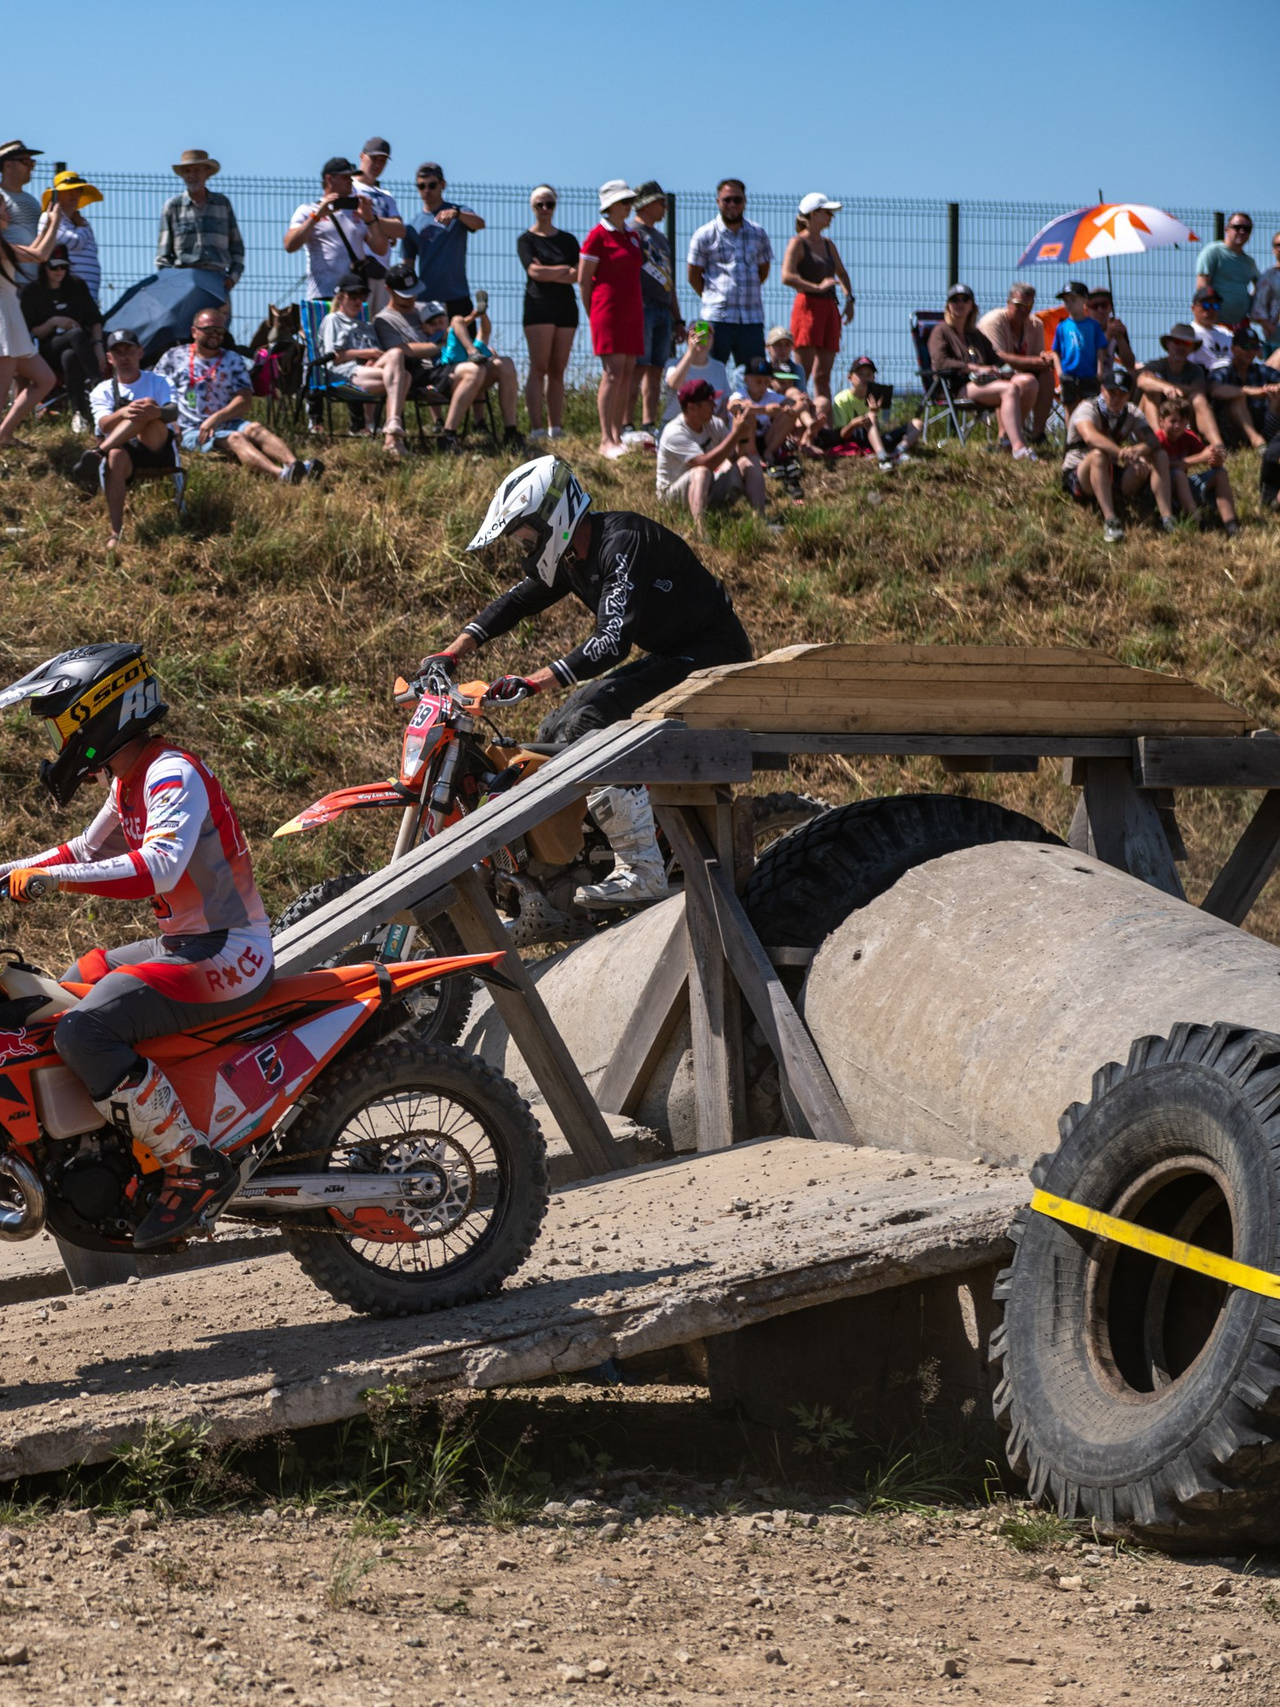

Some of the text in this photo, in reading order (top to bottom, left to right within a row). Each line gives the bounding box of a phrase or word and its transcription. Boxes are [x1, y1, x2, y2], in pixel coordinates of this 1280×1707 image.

[583, 637, 619, 662] Troy
[254, 1044, 285, 1085] 5
[8, 1111, 31, 1122] KTM
[223, 1125, 254, 1149] MOTOREX
[323, 1184, 345, 1194] KTM
